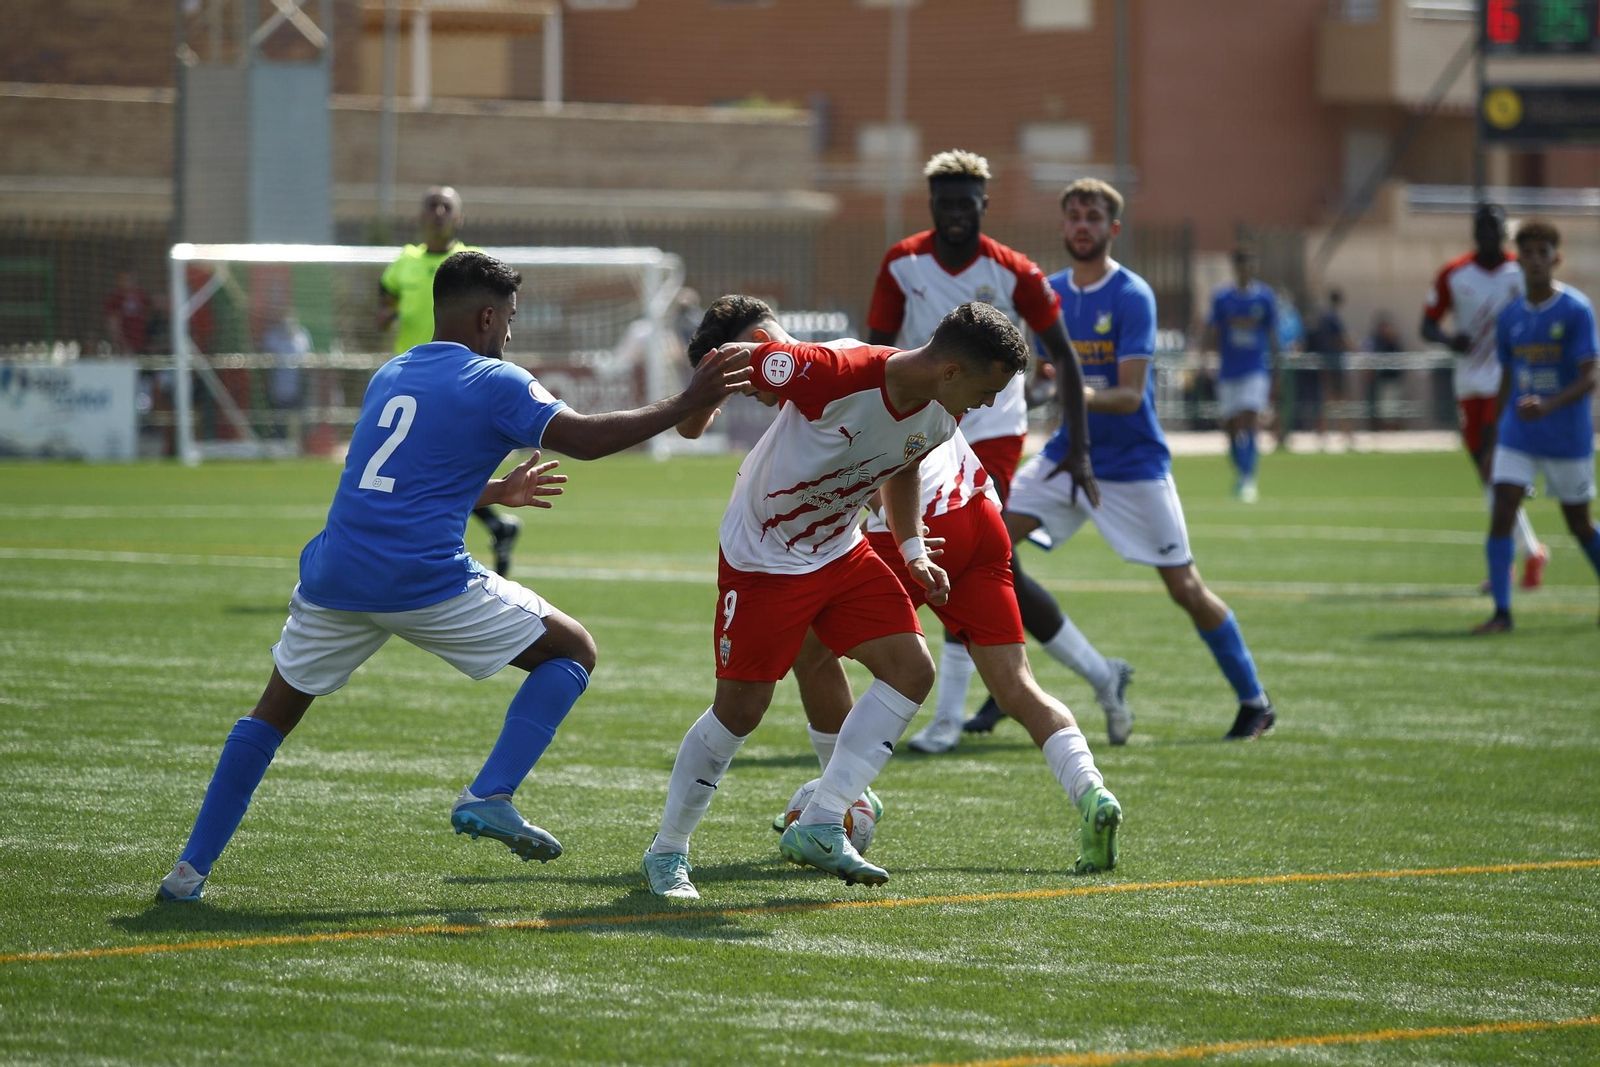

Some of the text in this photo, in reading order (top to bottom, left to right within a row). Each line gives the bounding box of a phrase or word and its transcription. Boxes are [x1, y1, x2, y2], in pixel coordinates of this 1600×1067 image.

[358, 394, 417, 493] 2
[797, 492, 833, 511] Arabian
[723, 589, 738, 631] 9
